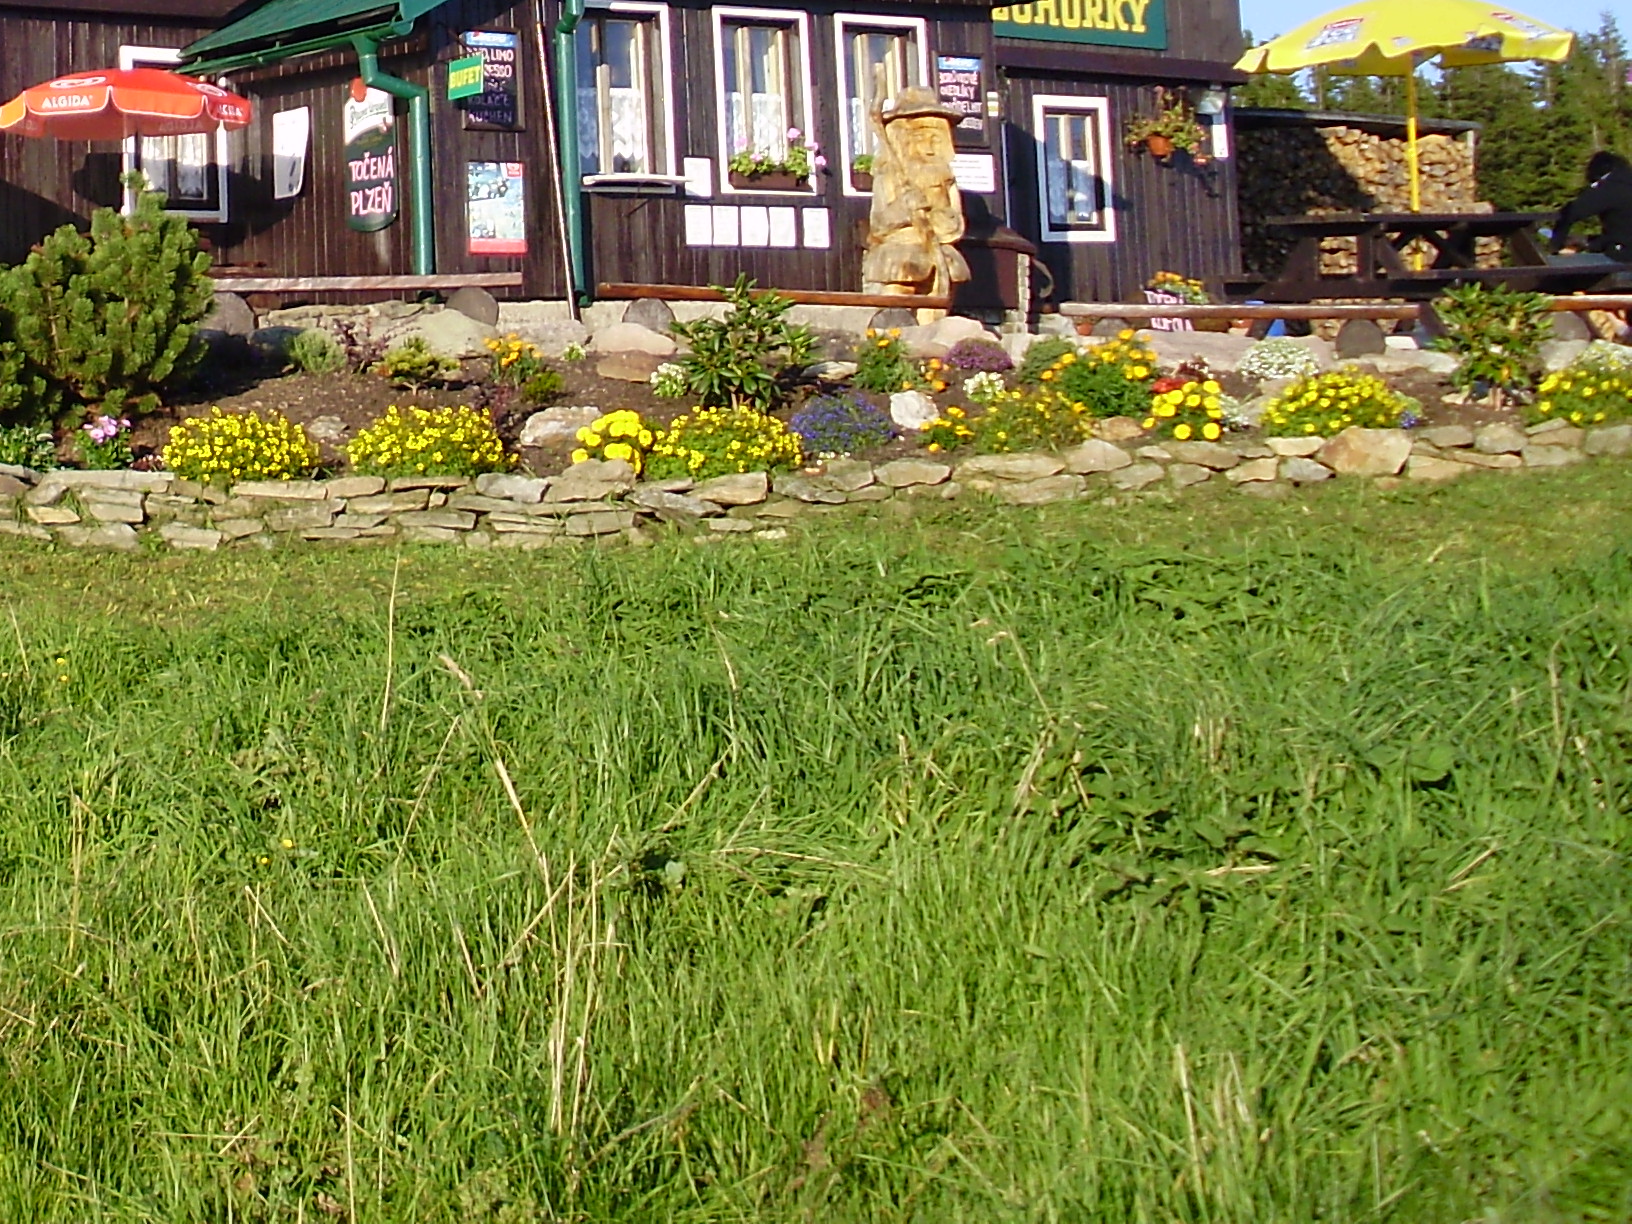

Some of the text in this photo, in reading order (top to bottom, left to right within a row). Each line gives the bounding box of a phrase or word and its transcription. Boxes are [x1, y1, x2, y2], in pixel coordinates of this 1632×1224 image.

[449, 65, 482, 89] BUFET
[41, 94, 90, 109] ALGIDA
[348, 146, 394, 182] TOČENÁ
[350, 182, 392, 215] PLZEŇ
